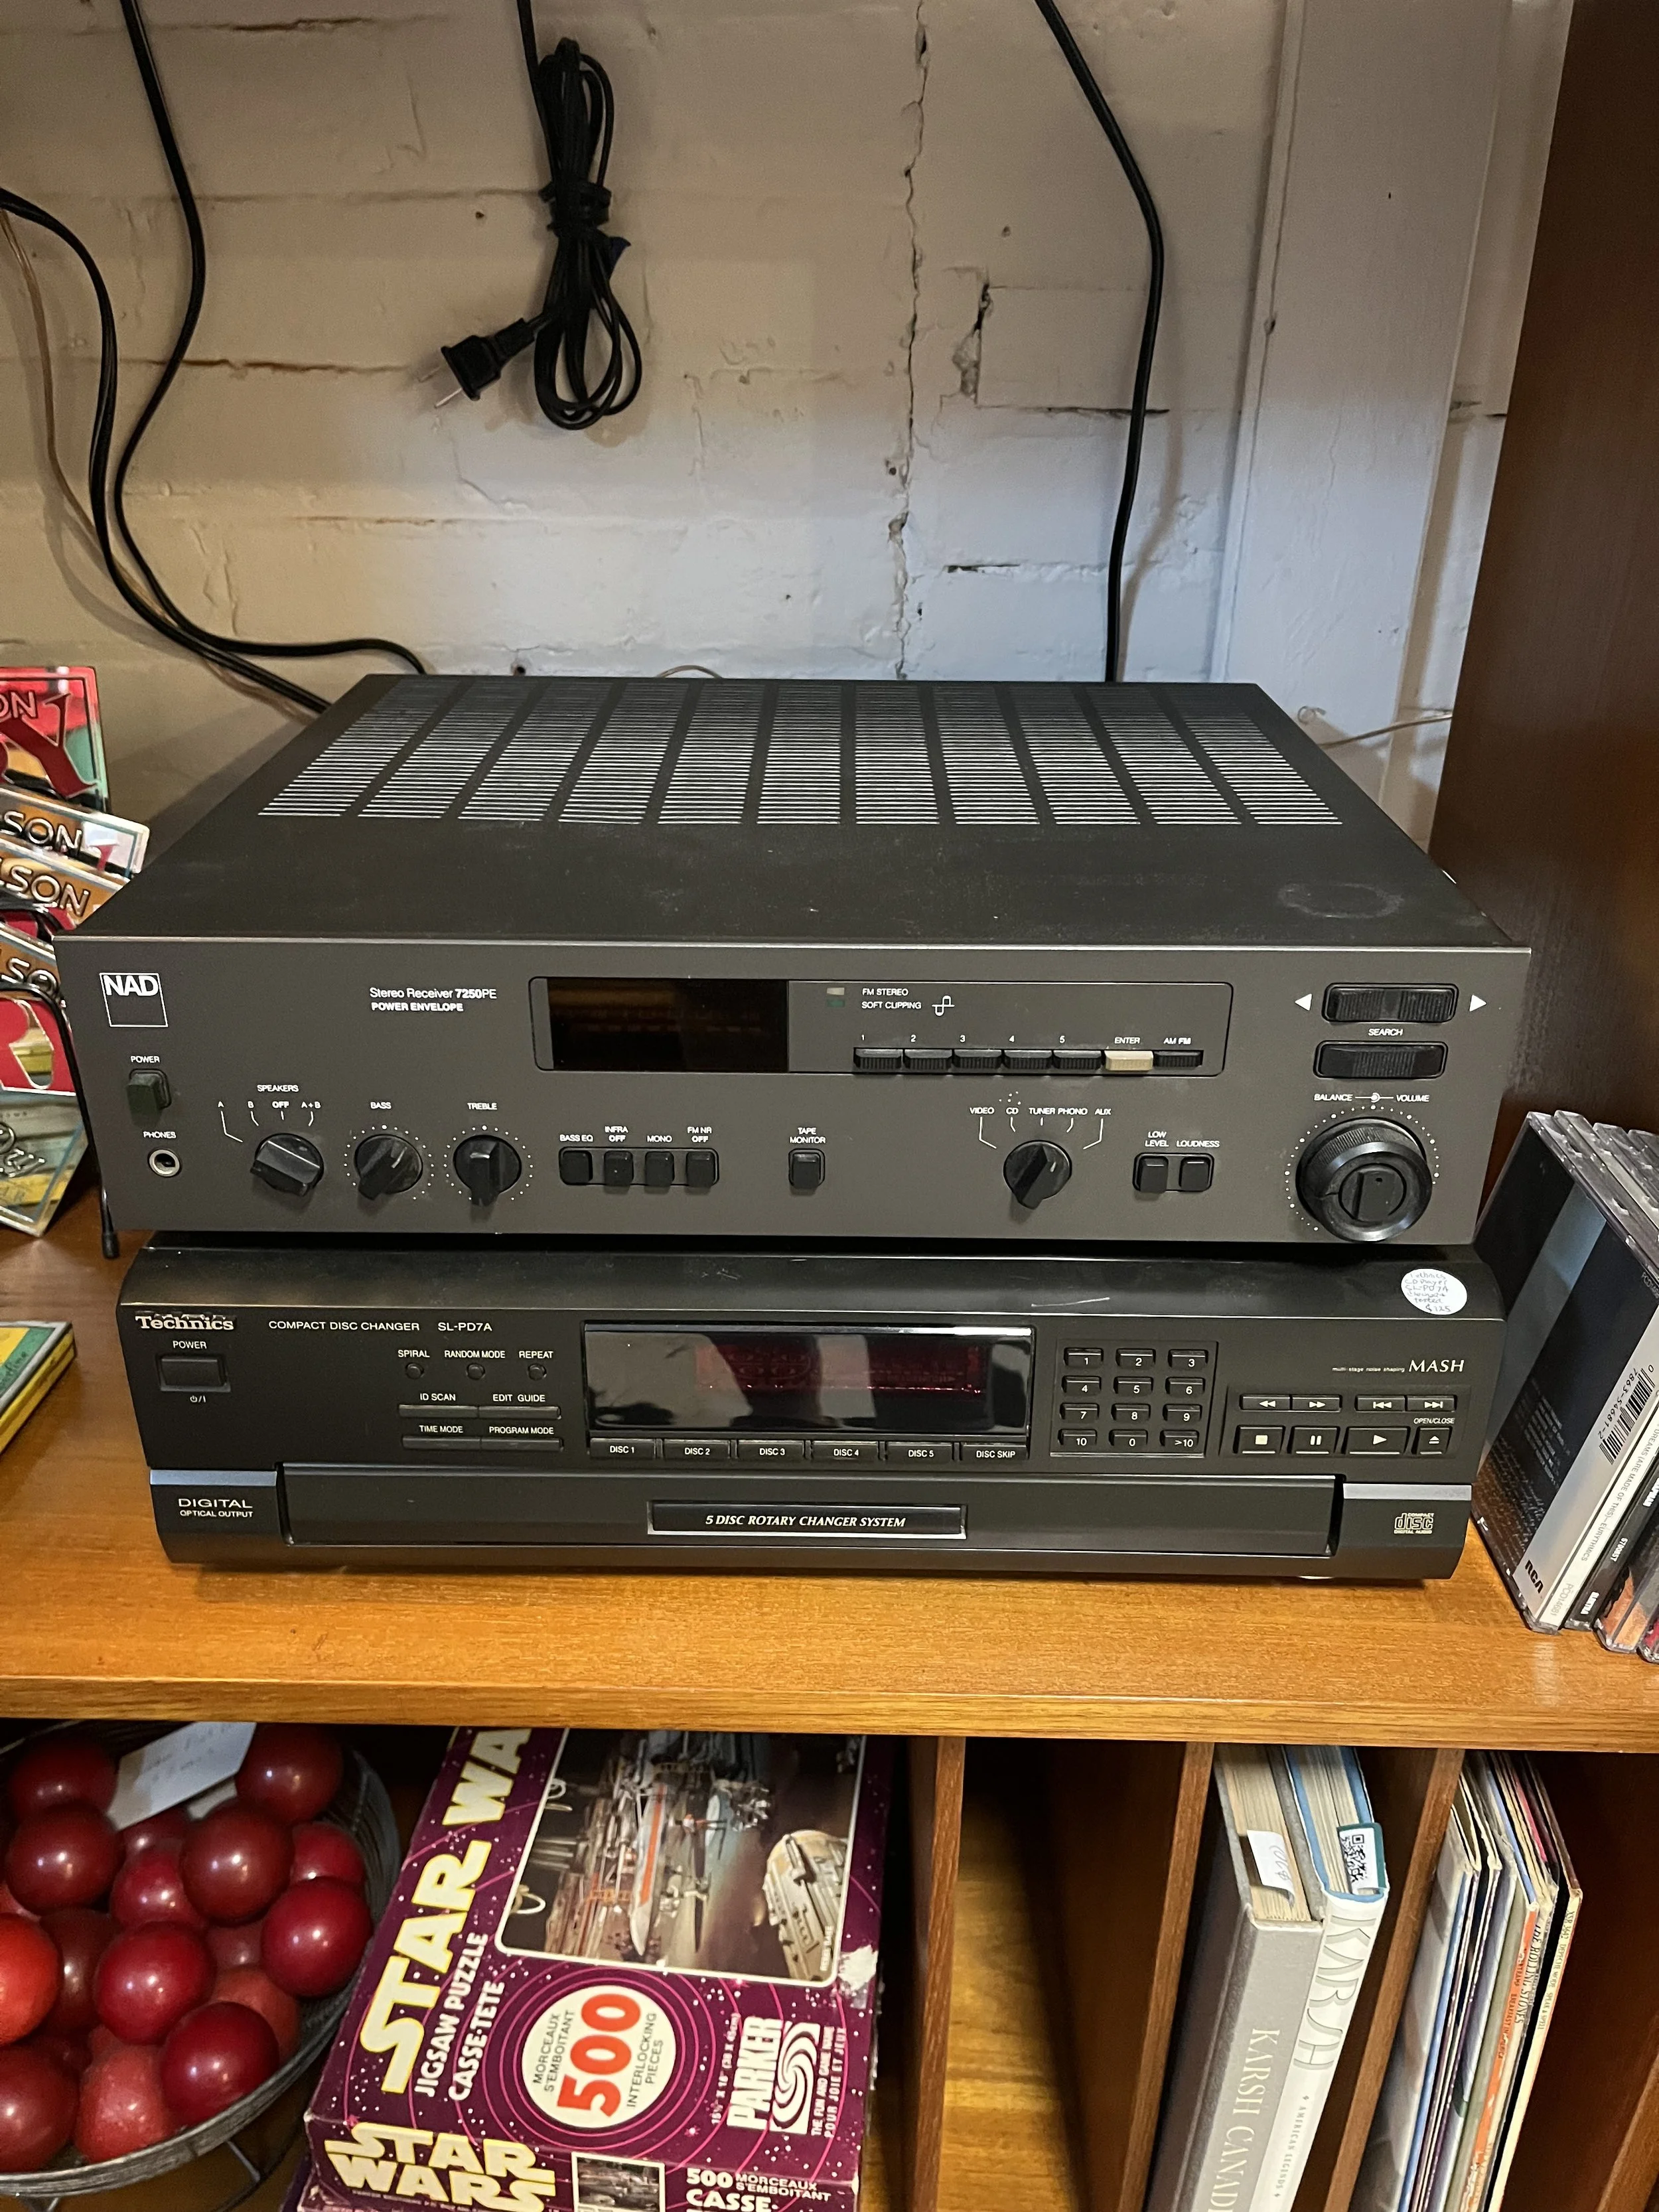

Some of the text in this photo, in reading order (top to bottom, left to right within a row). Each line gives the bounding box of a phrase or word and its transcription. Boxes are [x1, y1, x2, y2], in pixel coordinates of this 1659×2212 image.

[104, 975, 160, 997] NAD
[369, 987, 497, 999] Stereo Receiver 7250PE
[876, 988, 909, 996] STEREO
[371, 1001, 464, 1012] POWER ENVELOPE
[885, 1001, 922, 1009] CLIPPING
[1368, 1028, 1404, 1037] SEARCH
[910, 1034, 916, 1043] 2
[1313, 1093, 1353, 1102] BALANCE
[1396, 1094, 1430, 1102] VOLUME
[1057, 1107, 1088, 1116] PHONO
[559, 1134, 581, 1142] BASS
[1147, 1130, 1167, 1141] LOW
[1145, 1139, 1169, 1147] LEVEL
[135, 1315, 234, 1331] Technics
[268, 1321, 492, 1331] COMPACT DISC CHANGER SL-PD7A
[173, 1340, 207, 1349] POWER
[397, 1349, 431, 1358] SPIRAL
[444, 1350, 506, 1359] RANDOM MODE
[518, 1351, 554, 1359] REPEAT
[1135, 1357, 1142, 1366] 2
[1188, 1359, 1195, 1367] 3
[1408, 1359, 1465, 1372] MASH
[1648, 1364, 1654, 1373] 0
[1133, 1384, 1140, 1394] 5
[1185, 1386, 1192, 1395] 6
[419, 1392, 429, 1401] ID
[517, 1394, 545, 1402] GUIDE
[1080, 1411, 1087, 1420] 7
[1131, 1411, 1138, 1420] 8
[1183, 1412, 1190, 1422] 9
[488, 1426, 529, 1434] PROGRAM
[1076, 1438, 1087, 1446] 10
[1129, 1438, 1136, 1447] 0
[609, 1445, 629, 1453] DISC
[684, 1447, 704, 1455] DISC
[833, 1448, 853, 1457] DISC
[997, 1450, 1016, 1459] SKIP
[178, 1498, 253, 1511] DIGITAL
[705, 1515, 906, 1527] 5 DISC ROTARY CHANGER SYSTEM
[1394, 1512, 1433, 1530] disc
[1524, 1560, 1544, 1594] RCA
[359, 1839, 492, 2095] STAR
[441, 1728, 532, 1826] WA
[414, 1932, 488, 2098] JIGSAW PUZZLE
[533, 2013, 561, 2084] MORCEAUX
[556, 1993, 642, 2118] 500
[626, 2012, 658, 2108] INTERLOCKING
[644, 2039, 664, 2085] PIECES
[727, 2016, 784, 2130] PARKER
[824, 2027, 847, 2138] POUR JOIE ET JEUX
[814, 2098, 826, 2117] FUN
[1208, 2028, 1281, 2212] KARSH CANAD
[811, 2119, 824, 2136] THE
[1275, 2104, 1308, 2190] AMERICAN LEGENDS
[325, 2122, 555, 2184] STAR
[328, 2152, 555, 2212] WARS
[686, 2168, 734, 2189] 500
[735, 2173, 818, 2191] MORCEAUX
